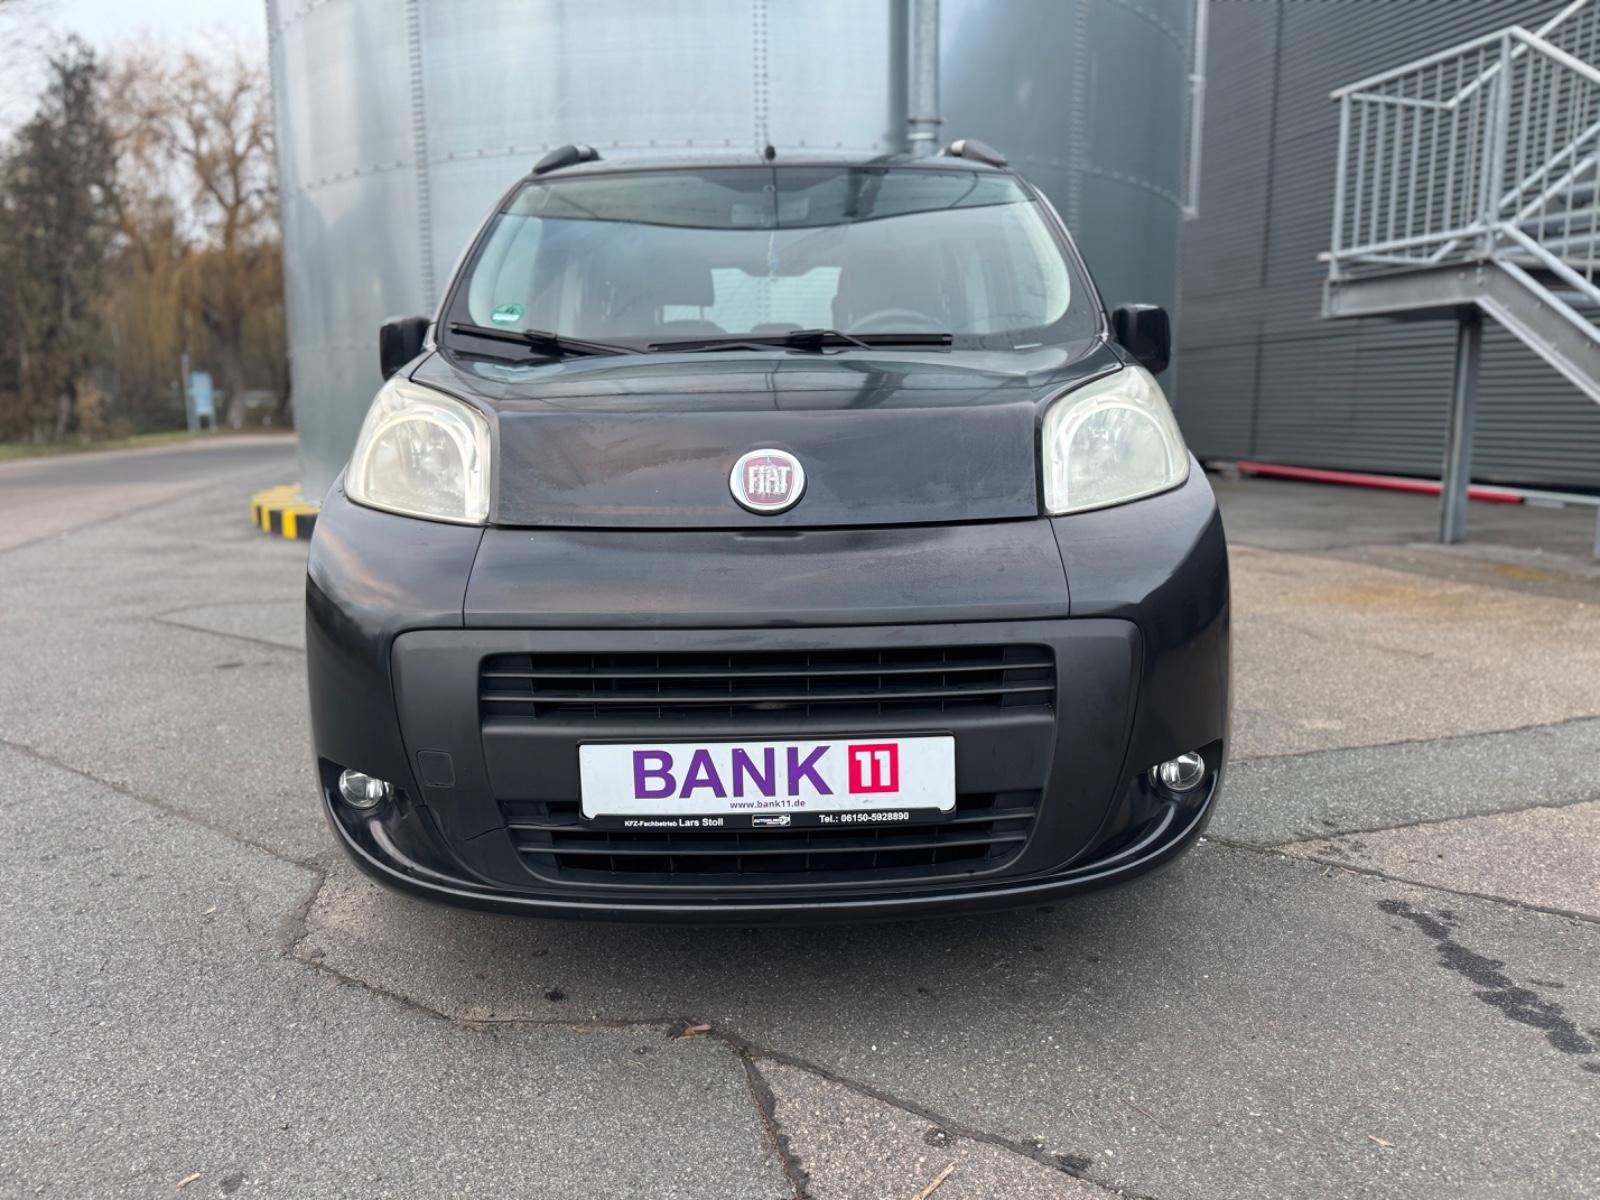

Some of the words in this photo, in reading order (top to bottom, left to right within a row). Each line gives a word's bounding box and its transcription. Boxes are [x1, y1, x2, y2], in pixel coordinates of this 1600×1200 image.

[748, 465, 790, 495] FIAT
[632, 745, 834, 800] BANK
[855, 750, 891, 788] 11
[730, 799, 805, 809] www.bank11.de
[679, 818, 699, 827] Lars
[702, 817, 724, 827] Stoll
[818, 814, 839, 823] Tel.:
[840, 811, 910, 822] 06150-5928890
